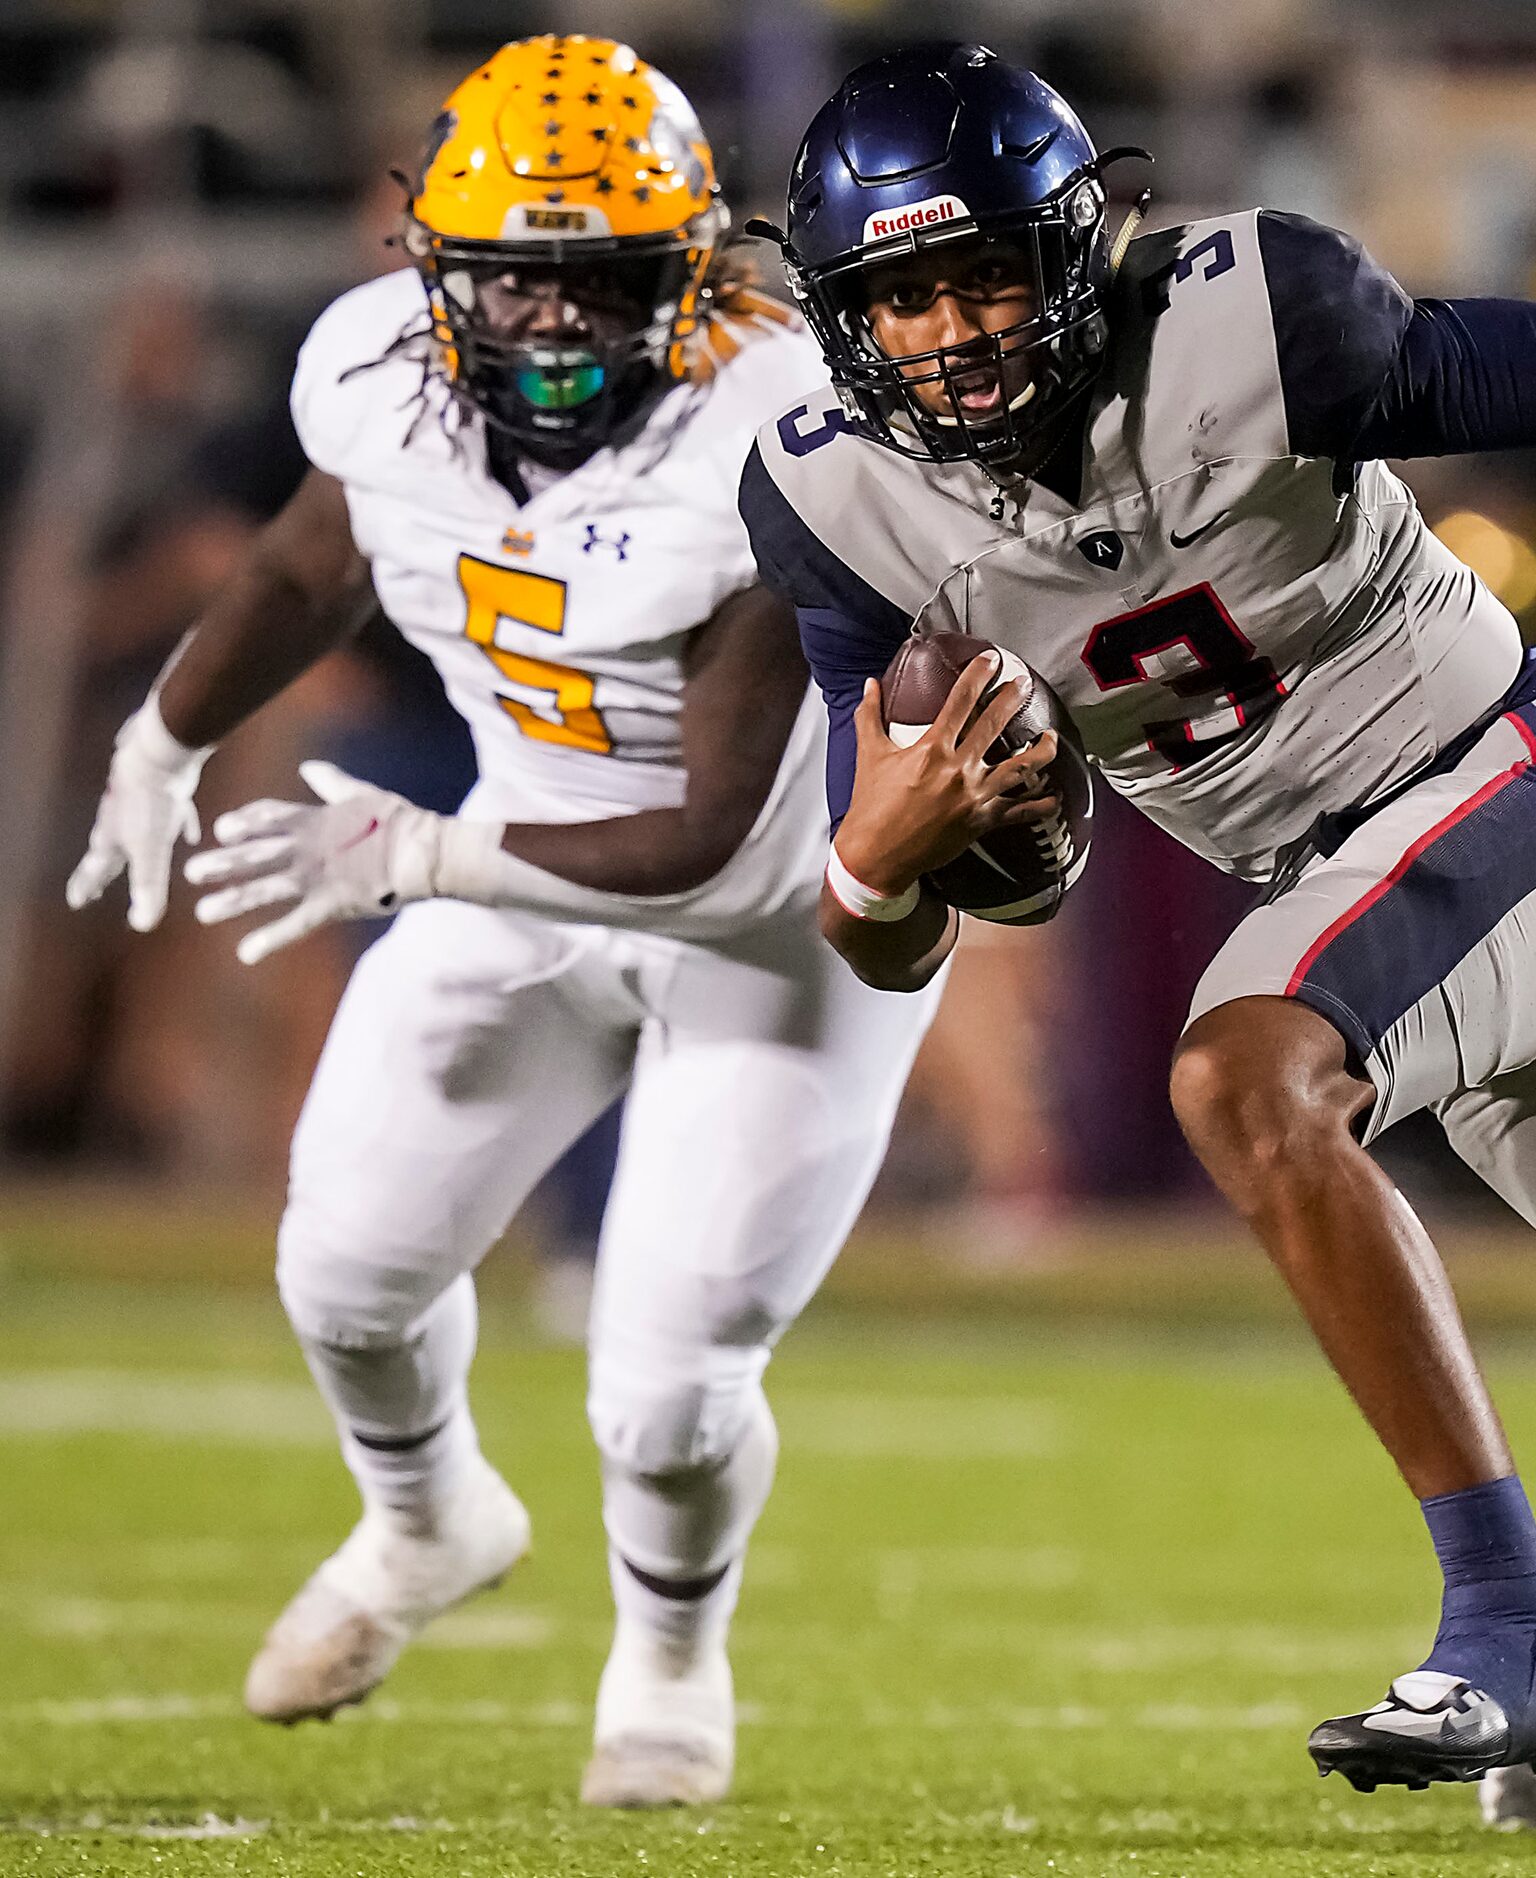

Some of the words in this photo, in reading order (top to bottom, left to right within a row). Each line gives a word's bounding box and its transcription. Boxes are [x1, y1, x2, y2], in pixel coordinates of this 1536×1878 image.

[872, 201, 954, 237] Riddell
[988, 497, 1005, 521] 3
[457, 551, 615, 760] 5
[1080, 580, 1290, 776] 3
